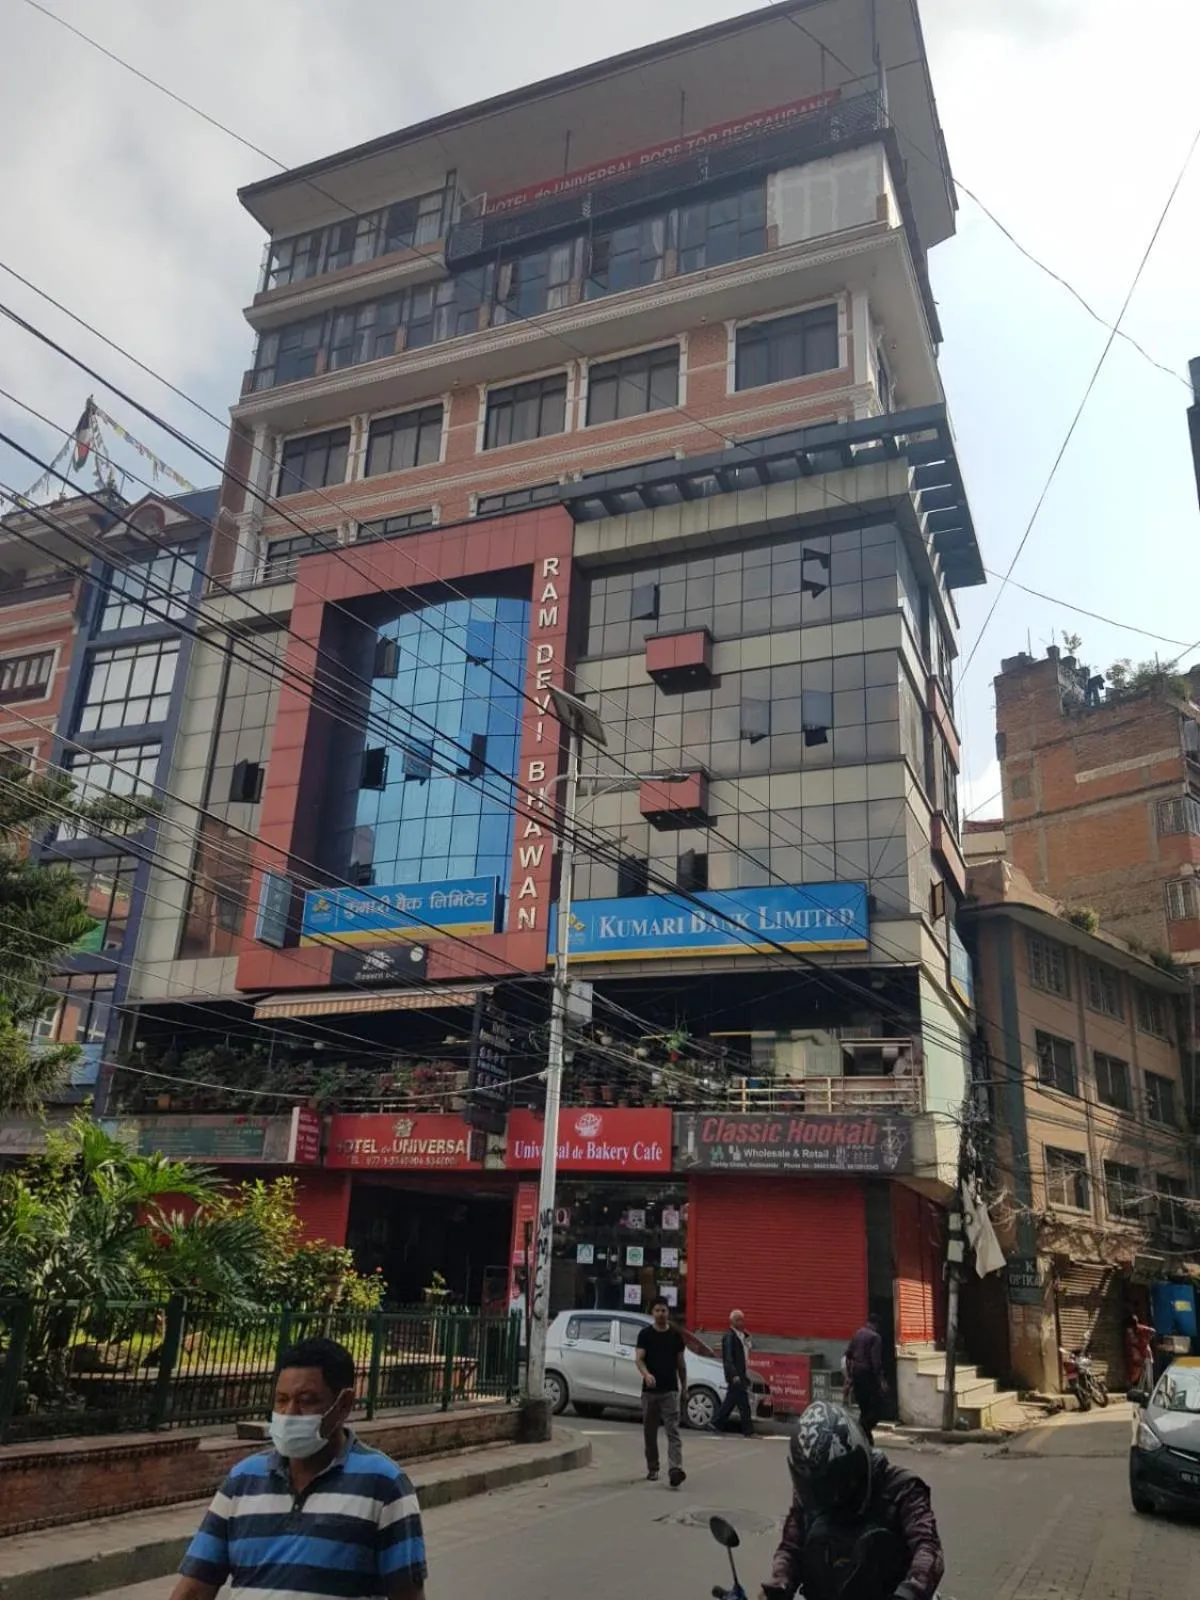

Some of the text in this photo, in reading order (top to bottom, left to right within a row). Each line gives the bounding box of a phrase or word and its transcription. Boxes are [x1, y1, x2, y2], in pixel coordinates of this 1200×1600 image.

[517, 557, 560, 930] RAM DEVI BHAWAN
[599, 905, 855, 939] KUMARI BANK LIMITED
[701, 1117, 880, 1145] Classic Hookah
[514, 1140, 663, 1162] Unival de Bakery Cafe
[743, 1149, 790, 1158] Wholesale
[792, 1149, 800, 1158] &
[802, 1150, 829, 1159] Retail
